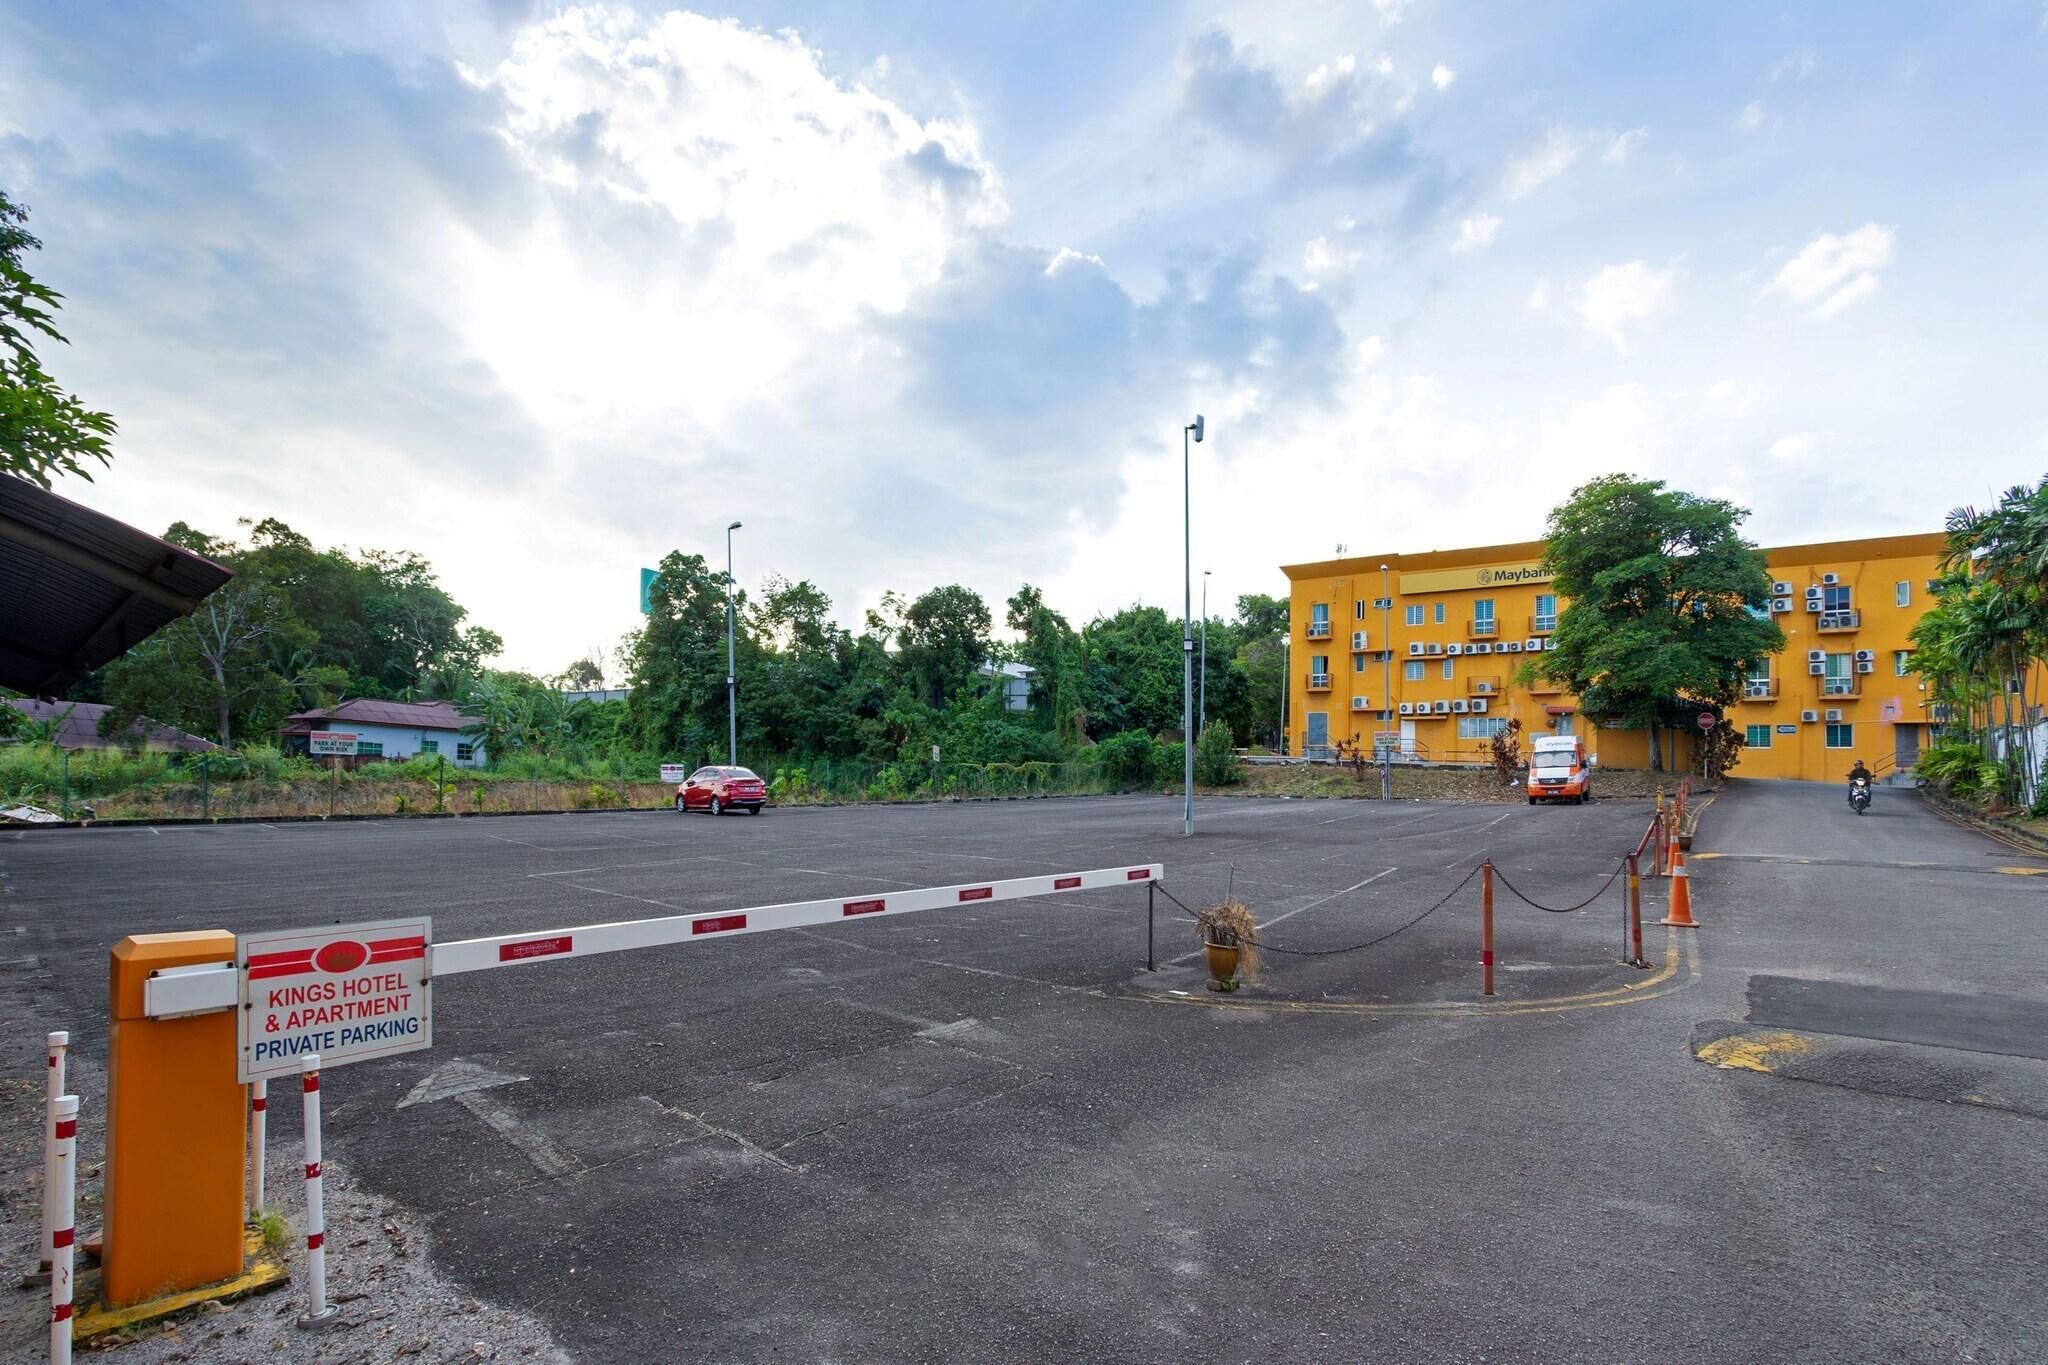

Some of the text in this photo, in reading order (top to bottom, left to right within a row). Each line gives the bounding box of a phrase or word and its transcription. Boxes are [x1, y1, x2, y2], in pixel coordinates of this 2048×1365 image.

[269, 973, 408, 1008] KINGS HOTEL
[265, 994, 411, 1033] & APARTMENT
[255, 1017, 418, 1061] PRIVATE PARKING
